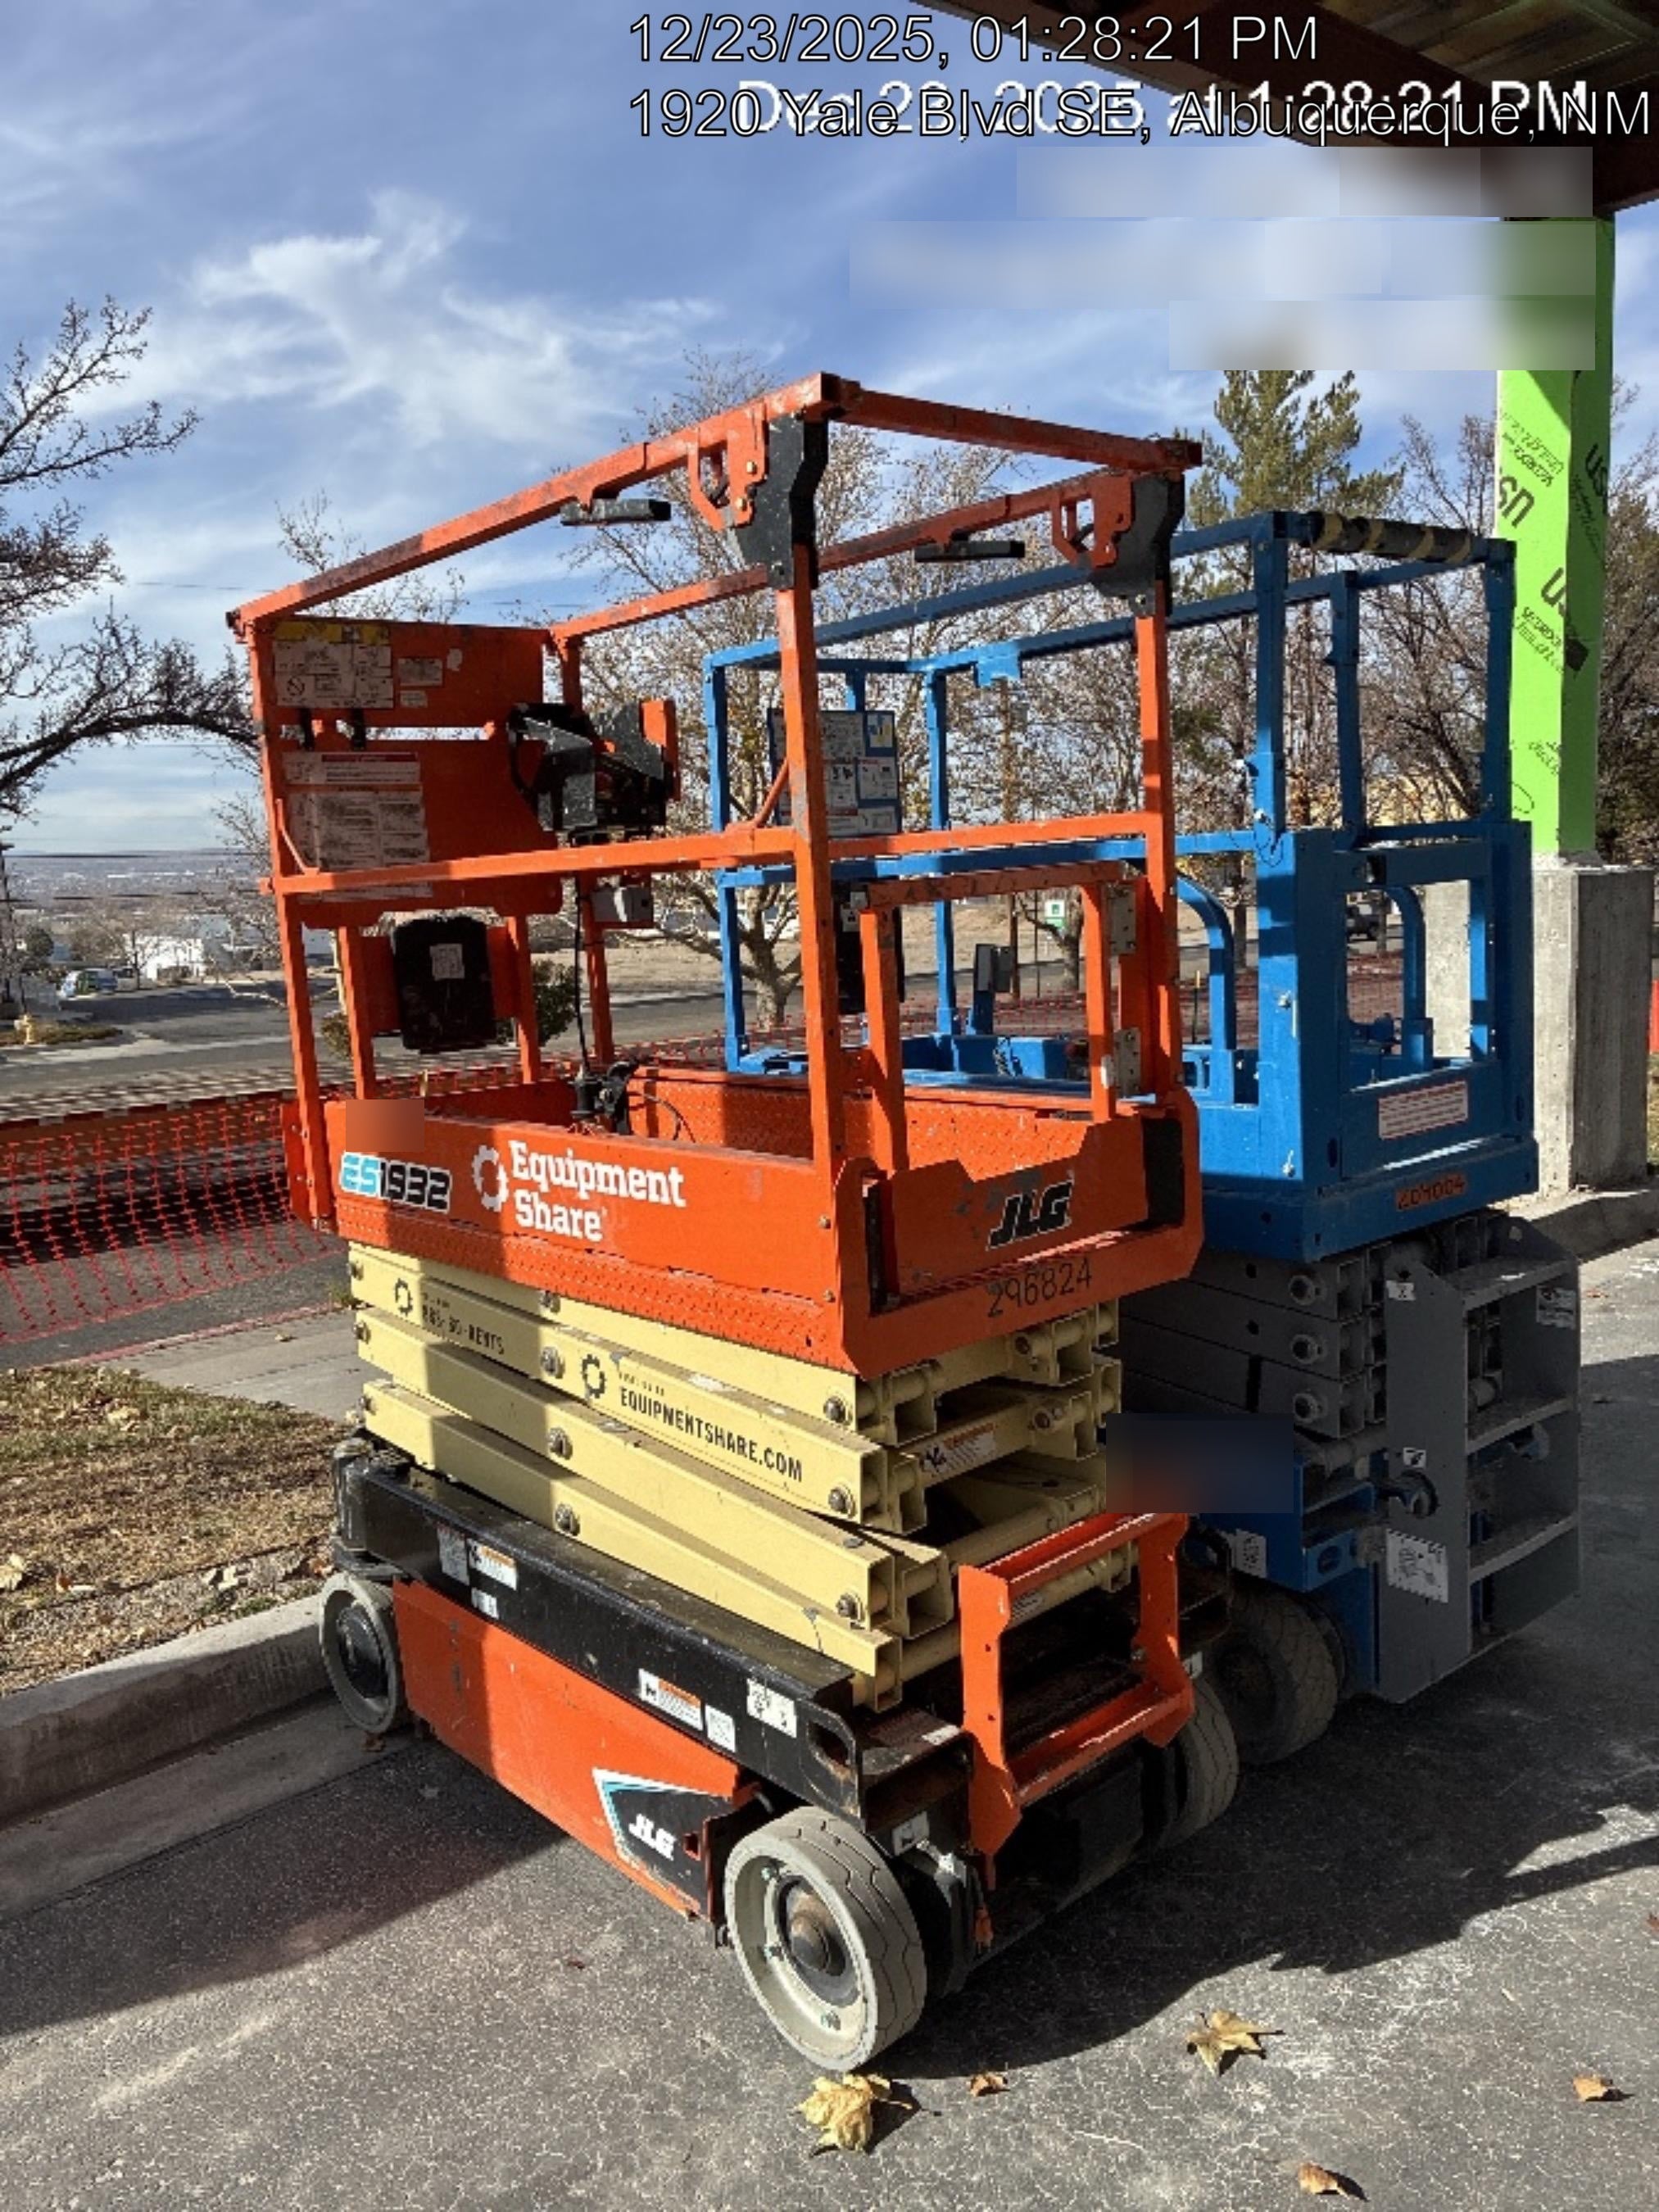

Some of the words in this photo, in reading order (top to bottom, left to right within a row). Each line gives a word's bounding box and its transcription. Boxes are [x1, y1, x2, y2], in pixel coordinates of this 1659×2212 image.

[340, 1153, 452, 1213] ES1932
[508, 1140, 687, 1208] Equipment
[514, 1189, 603, 1243] Share
[986, 1180, 1074, 1252] JLG
[987, 1256, 1092, 1318] 296824
[620, 1386, 803, 1483] EQUIPMENTSHARE.COM
[628, 1813, 678, 1861] JLG
